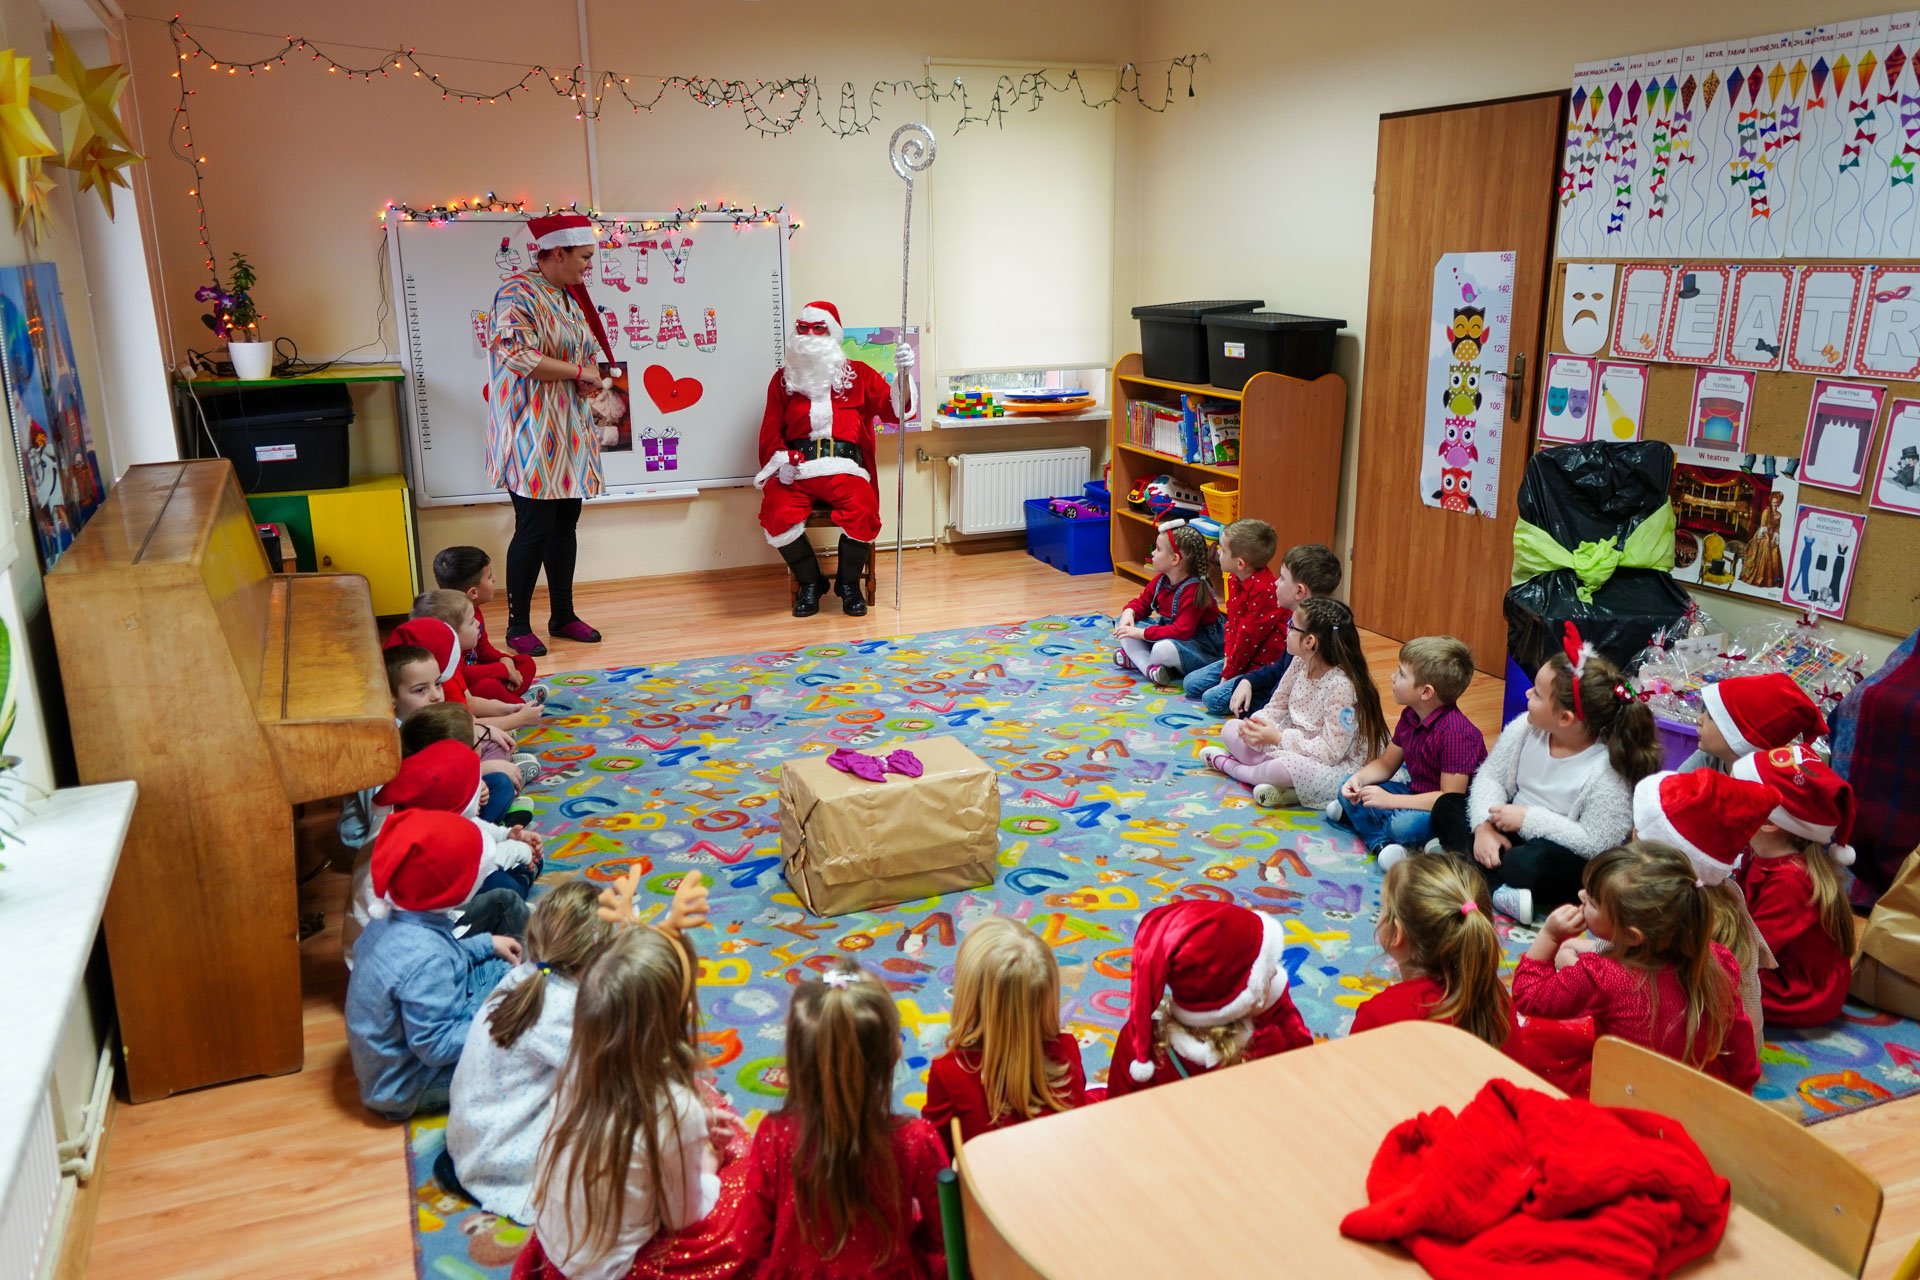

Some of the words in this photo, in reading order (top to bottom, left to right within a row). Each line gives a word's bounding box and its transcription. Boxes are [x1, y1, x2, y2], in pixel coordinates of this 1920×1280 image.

[1860, 27, 1879, 35] KUBA
[1499, 253, 1512, 263] 150
[1498, 284, 1510, 294] 140
[1495, 314, 1508, 324] 130
[1493, 344, 1505, 353] 120
[1489, 402, 1501, 411] 100
[1488, 429, 1497, 438] 90
[1487, 456, 1495, 465] 80
[1707, 454, 1730, 462] teatrze
[1485, 483, 1493, 492] 70
